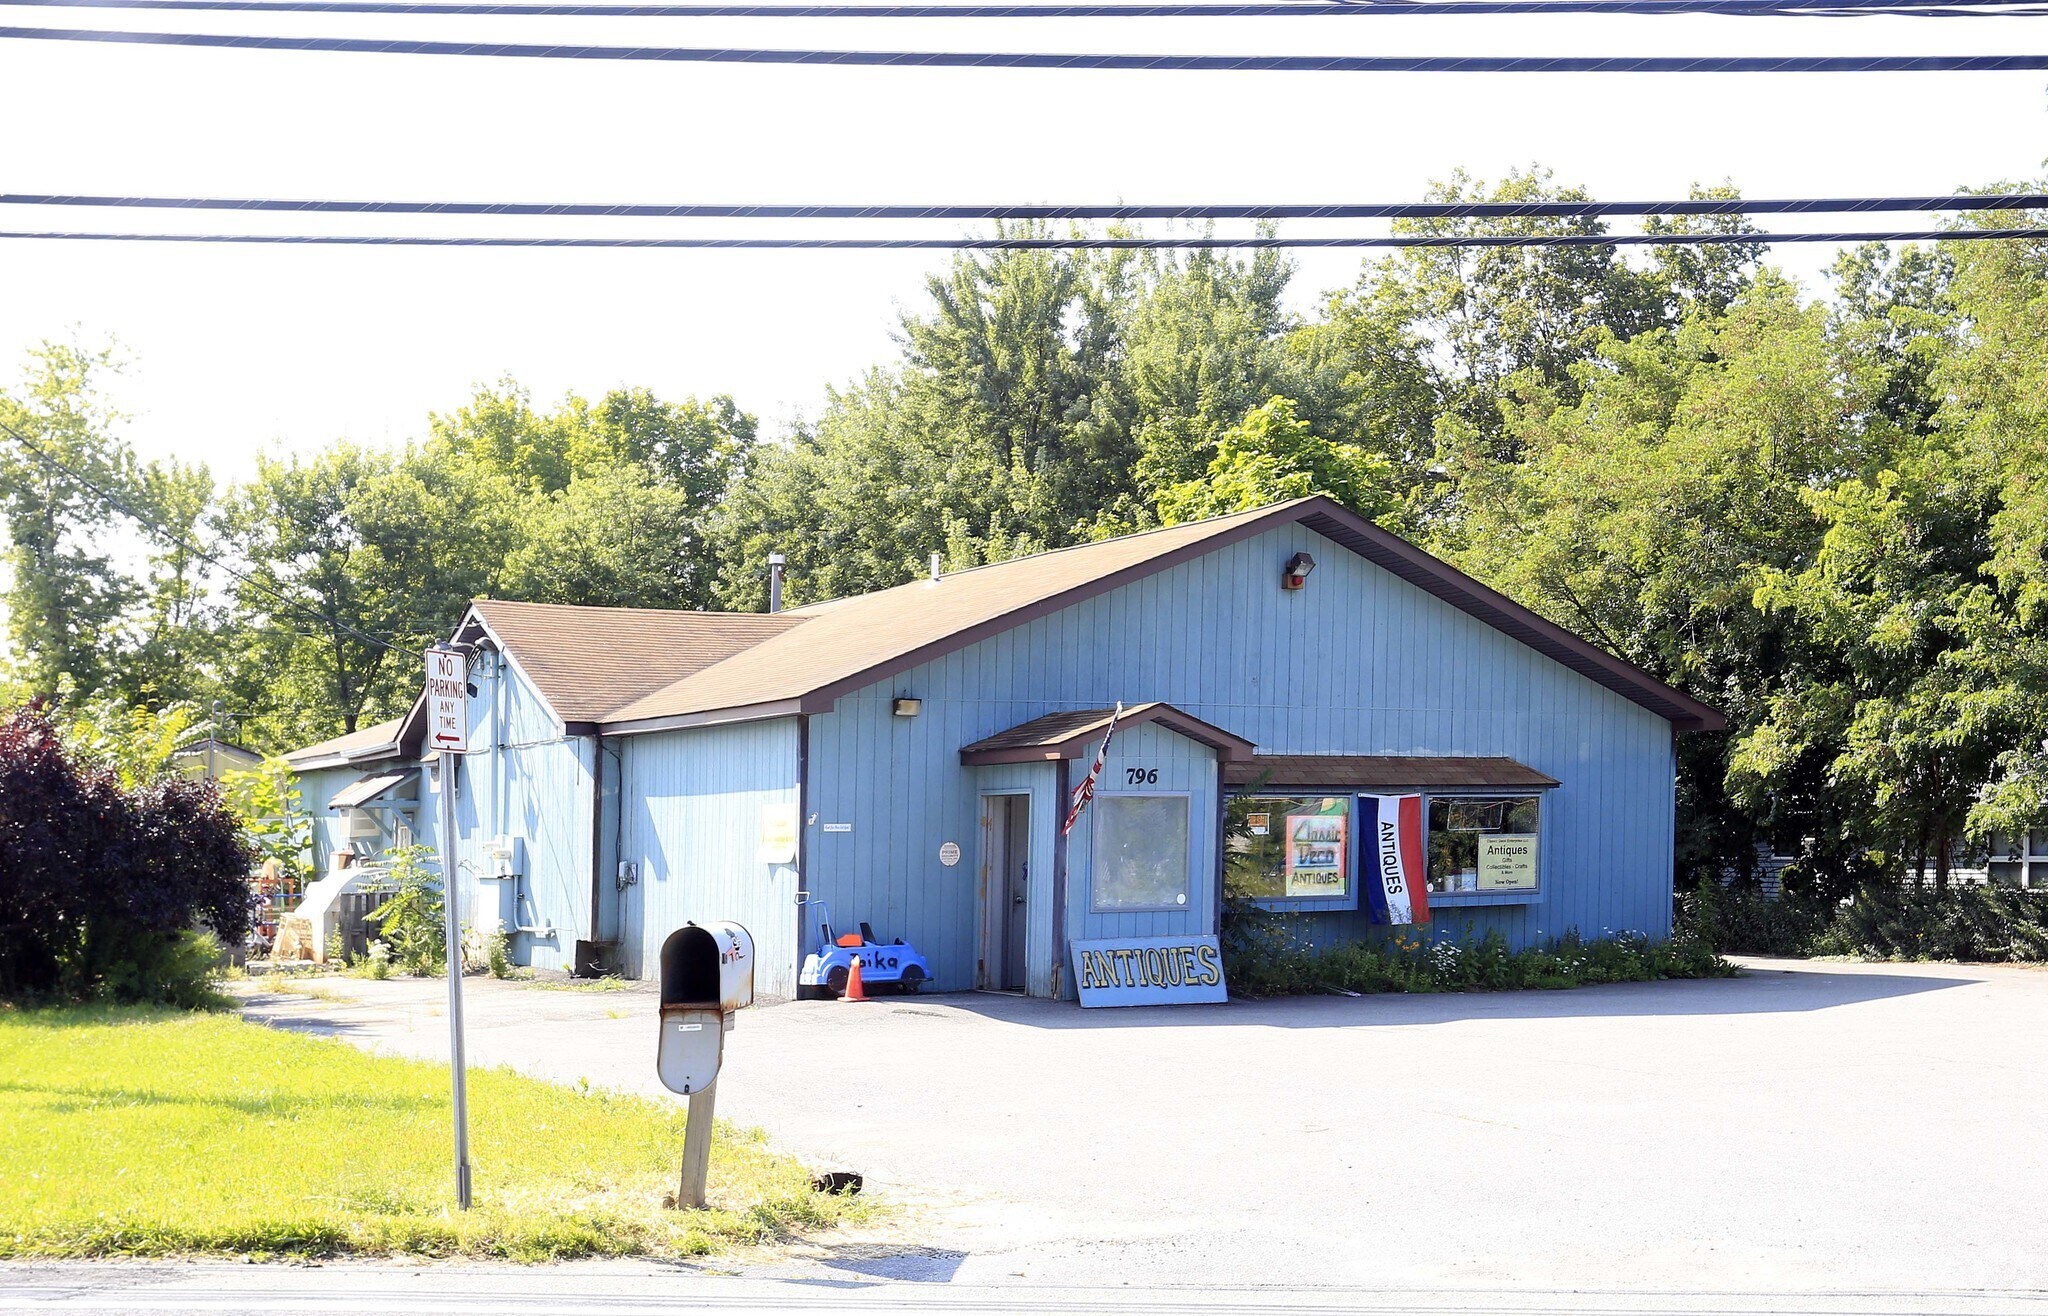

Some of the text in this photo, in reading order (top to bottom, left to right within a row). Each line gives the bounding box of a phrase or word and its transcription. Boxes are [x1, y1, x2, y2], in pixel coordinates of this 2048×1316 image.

[438, 657, 453, 676] NO
[429, 678, 463, 699] PARKING
[440, 700, 455, 713] ANY
[439, 716, 456, 729] TIME
[1126, 767, 1159, 785] 796
[1380, 821, 1403, 895] ANTIQUES
[1487, 845, 1528, 857] Antiques
[1291, 871, 1339, 885] ANTIQUES
[1081, 945, 1220, 989] ANTIQUES
